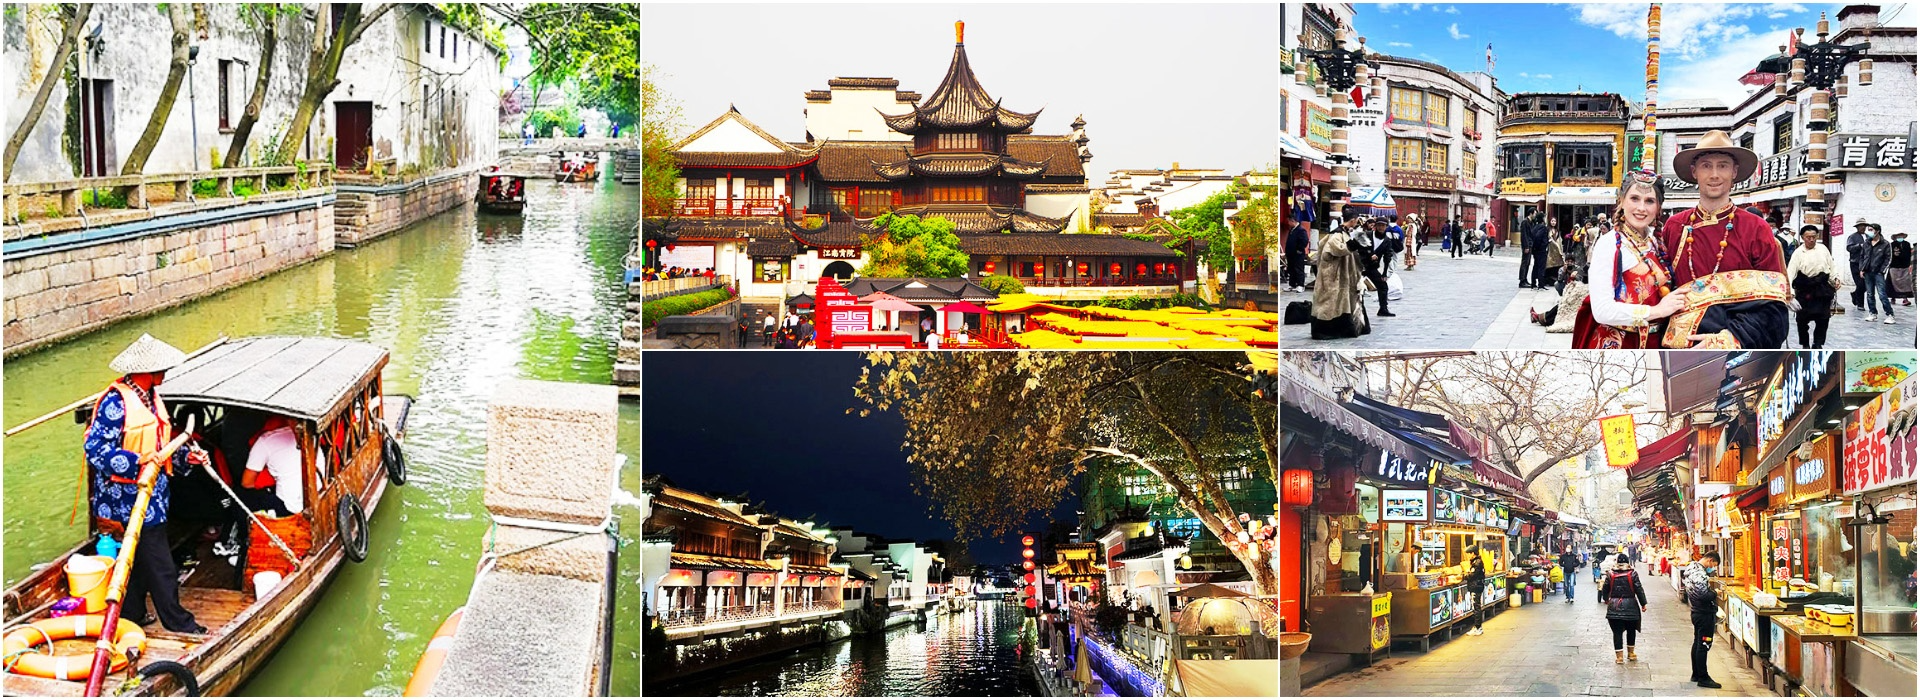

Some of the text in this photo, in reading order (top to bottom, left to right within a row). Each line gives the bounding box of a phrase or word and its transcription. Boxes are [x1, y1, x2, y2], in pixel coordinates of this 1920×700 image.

[1762, 154, 1788, 184] 肯德基
[1843, 429, 1887, 492] 菠萝饭
[1773, 526, 1791, 582] 肉夹馍
